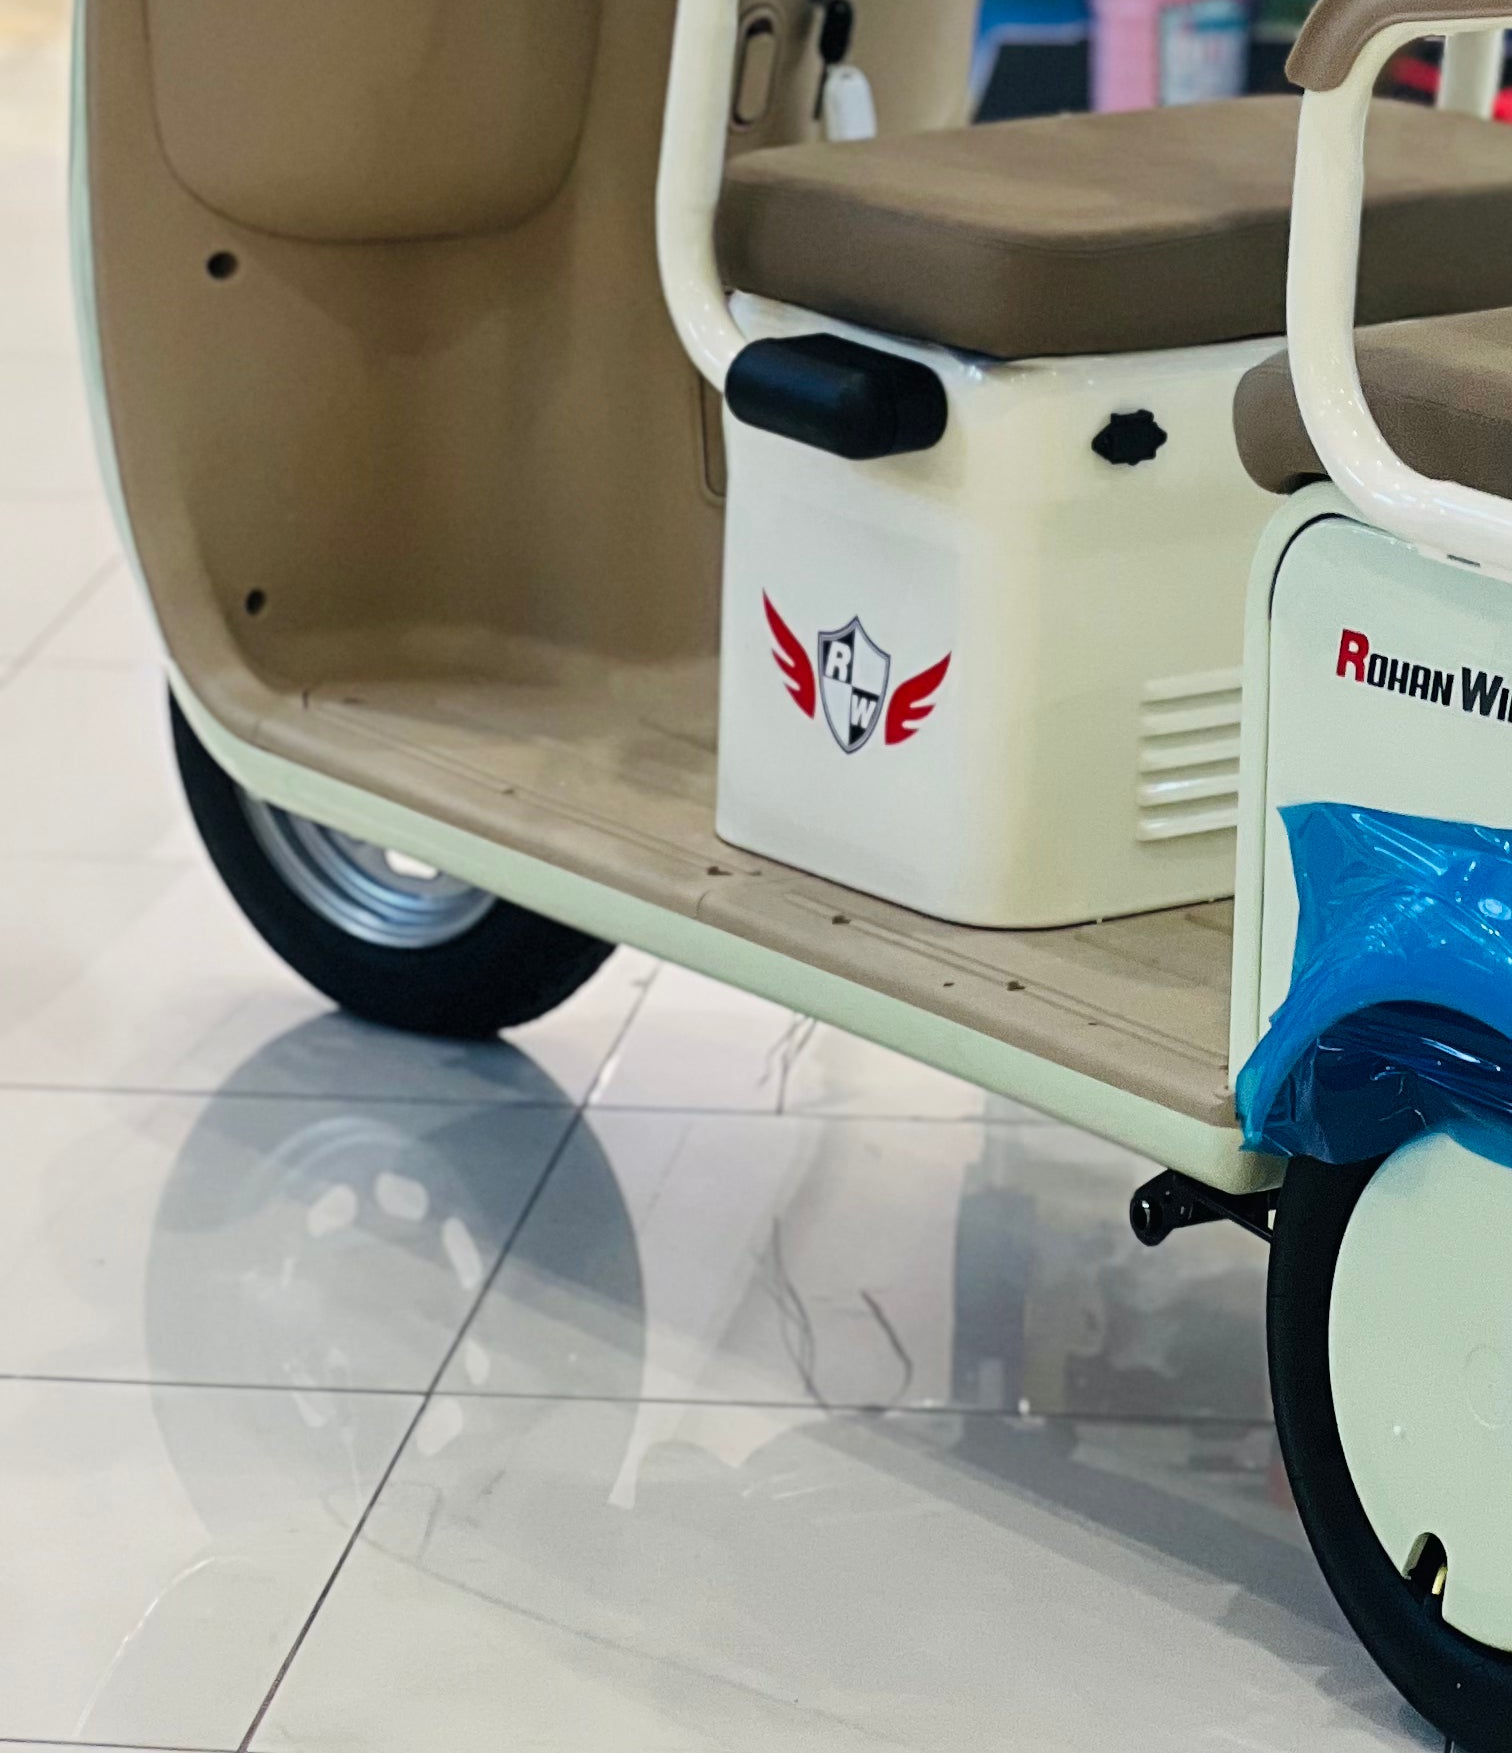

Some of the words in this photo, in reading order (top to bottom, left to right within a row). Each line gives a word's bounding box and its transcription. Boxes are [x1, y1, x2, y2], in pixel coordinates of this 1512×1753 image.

[825, 640, 852, 682] R
[1335, 628, 1455, 707] ROHAN
[850, 694, 877, 729] W
